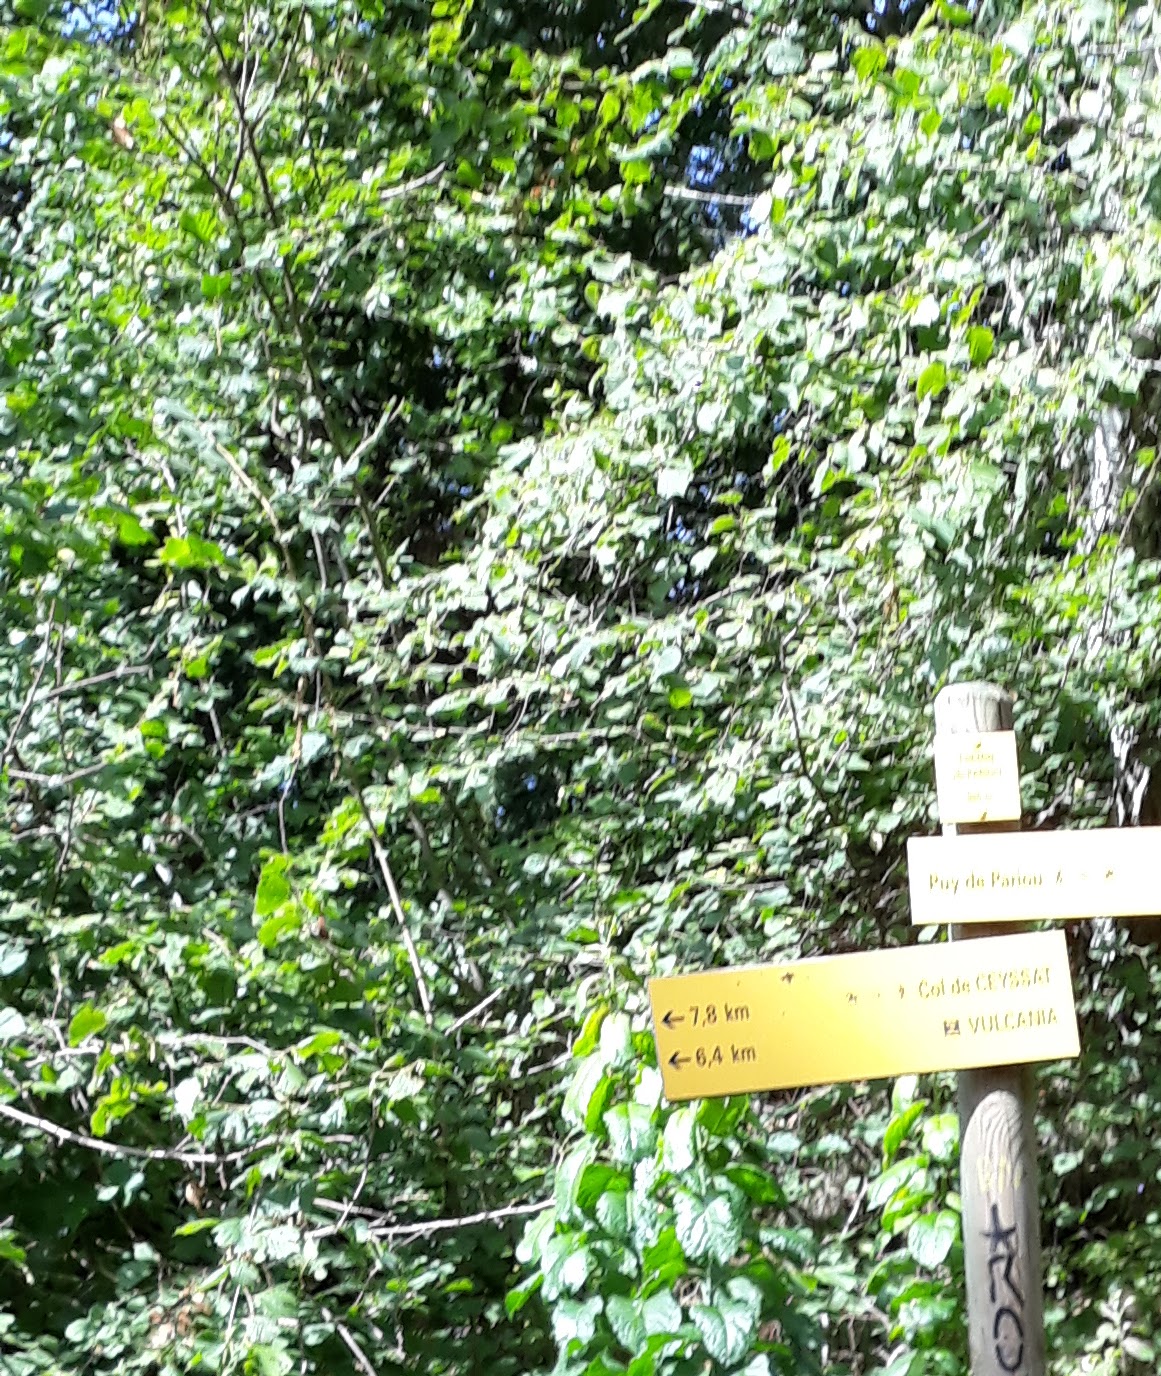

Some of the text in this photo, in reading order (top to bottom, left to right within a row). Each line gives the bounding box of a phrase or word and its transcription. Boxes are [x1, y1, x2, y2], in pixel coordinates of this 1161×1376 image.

[918, 977, 945, 999] Col
[689, 1001, 750, 1028] 7,8 km
[967, 1007, 1060, 1035] VULCANIA
[695, 1043, 756, 1069] 6,4 km
